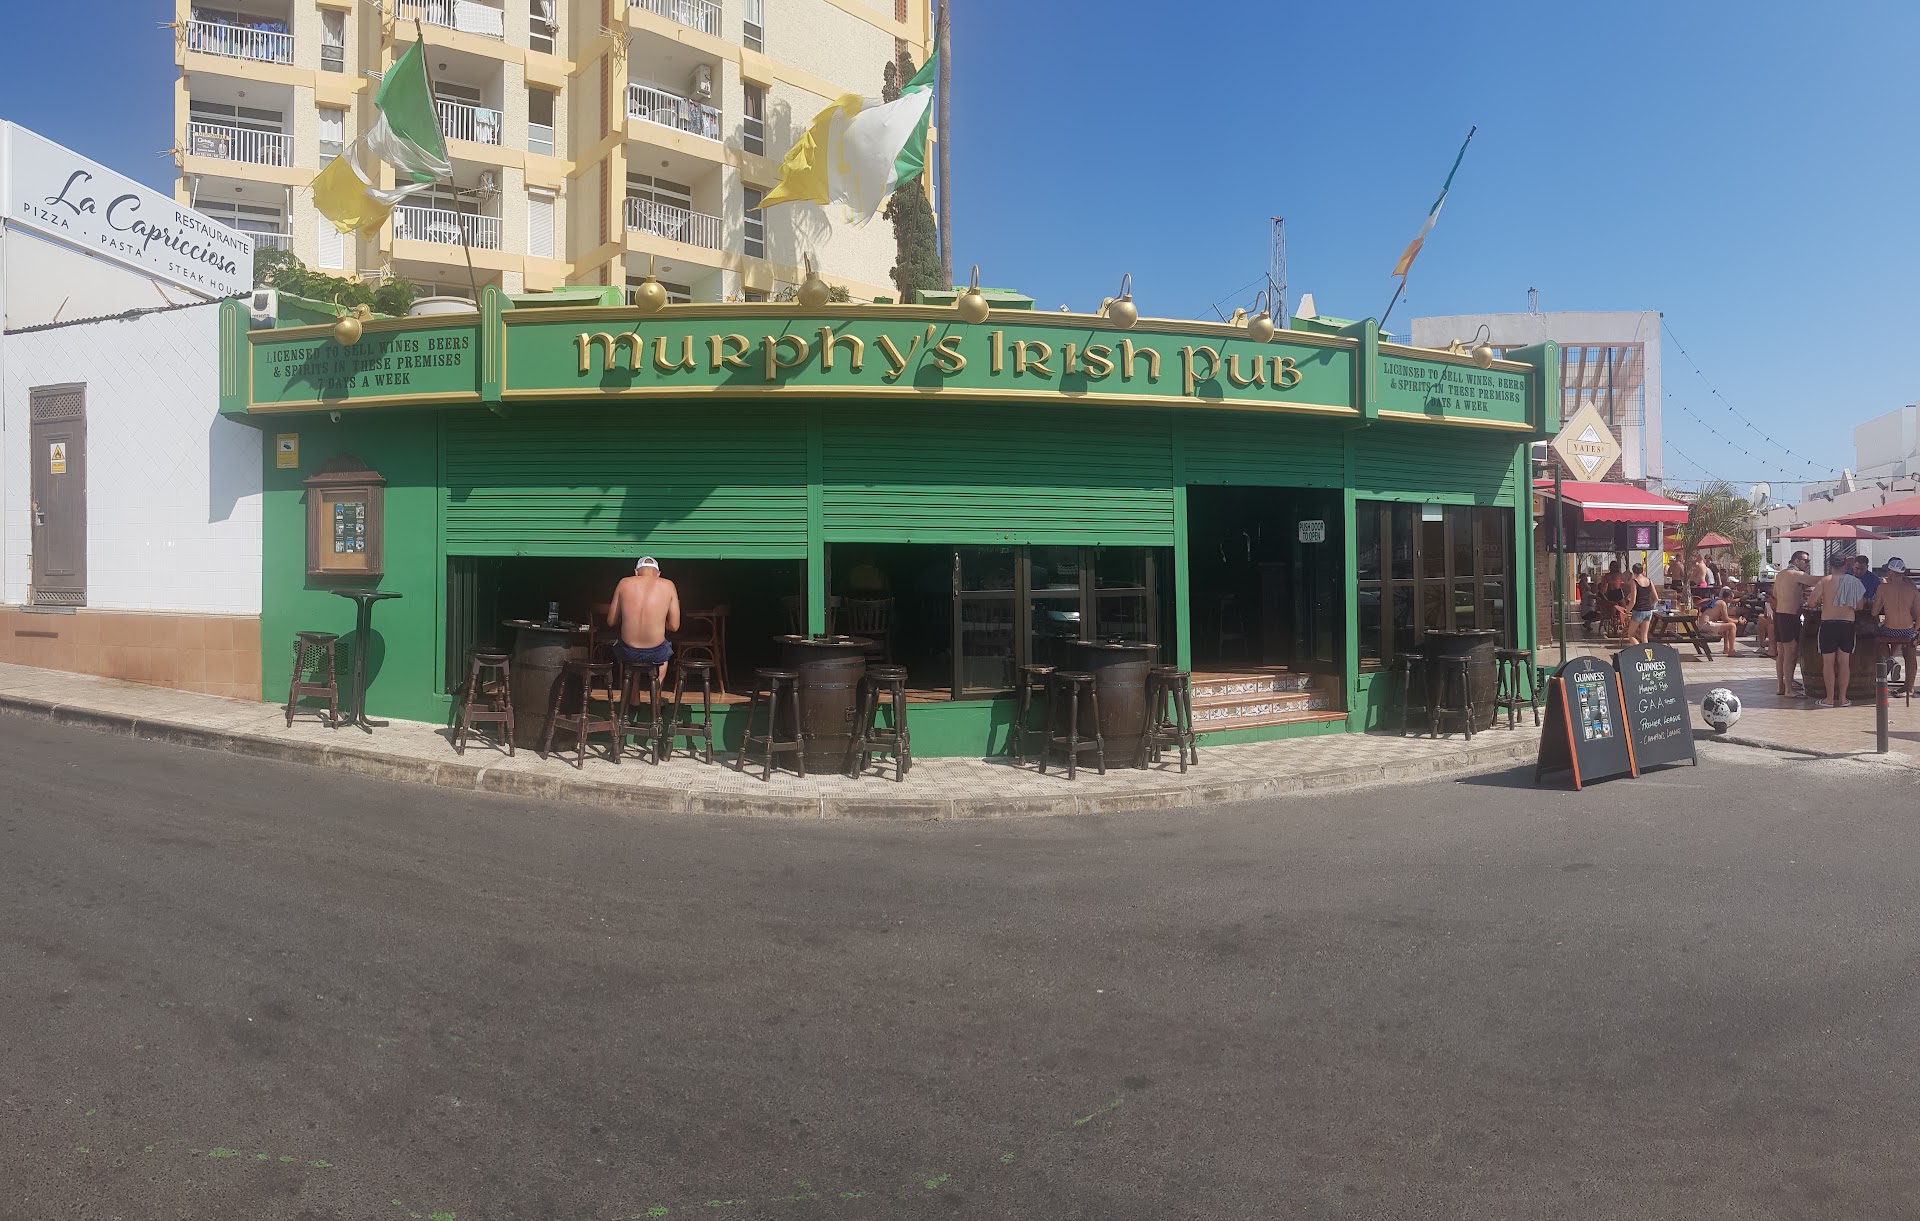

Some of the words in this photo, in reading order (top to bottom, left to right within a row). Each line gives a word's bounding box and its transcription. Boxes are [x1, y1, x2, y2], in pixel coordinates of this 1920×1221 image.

[44, 170, 97, 215] La
[106, 193, 237, 275] Capricciosa
[175, 211, 249, 255] RESTAURANTE
[23, 202, 70, 230] PIZZA
[101, 234, 143, 258] PASTA
[168, 262, 204, 283] STEAK
[210, 279, 239, 295] HOUS
[266, 347, 320, 364] LICENSED
[324, 346, 339, 358] TO
[344, 344, 374, 357] SELL
[378, 339, 419, 355] WINES
[428, 336, 469, 351] BEERS
[273, 366, 281, 378] &
[284, 362, 329, 377] SPIRITS
[334, 360, 346, 372] IN
[352, 357, 391, 372] THESE
[396, 353, 461, 370] PREMISES
[317, 378, 324, 389] 7
[327, 375, 356, 389] DAYS
[361, 375, 370, 387] A
[374, 372, 410, 387] WEEK
[1383, 362, 1425, 379] LICENSED
[1428, 368, 1438, 380] TO
[1442, 369, 1464, 383] SELL
[1466, 373, 1495, 388] WINES,
[1498, 377, 1525, 391] BEERS
[1390, 378, 1398, 389] &
[1398, 379, 1431, 393] SPIRITS
[1434, 383, 1444, 394] IN
[1447, 384, 1475, 398] THESE
[1478, 389, 1520, 404] PREMISES
[1431, 396, 1451, 409] DAYS
[1455, 399, 1461, 410] A
[1299, 522, 1311, 531] PUSH
[1311, 522, 1324, 531] DOOR
[1302, 531, 1309, 540] TO
[1309, 531, 1321, 540] OPEN
[1635, 661, 1667, 672] GUINNESS
[1573, 672, 1605, 683] GUINNESS
[1638, 697, 1665, 713] GAA
